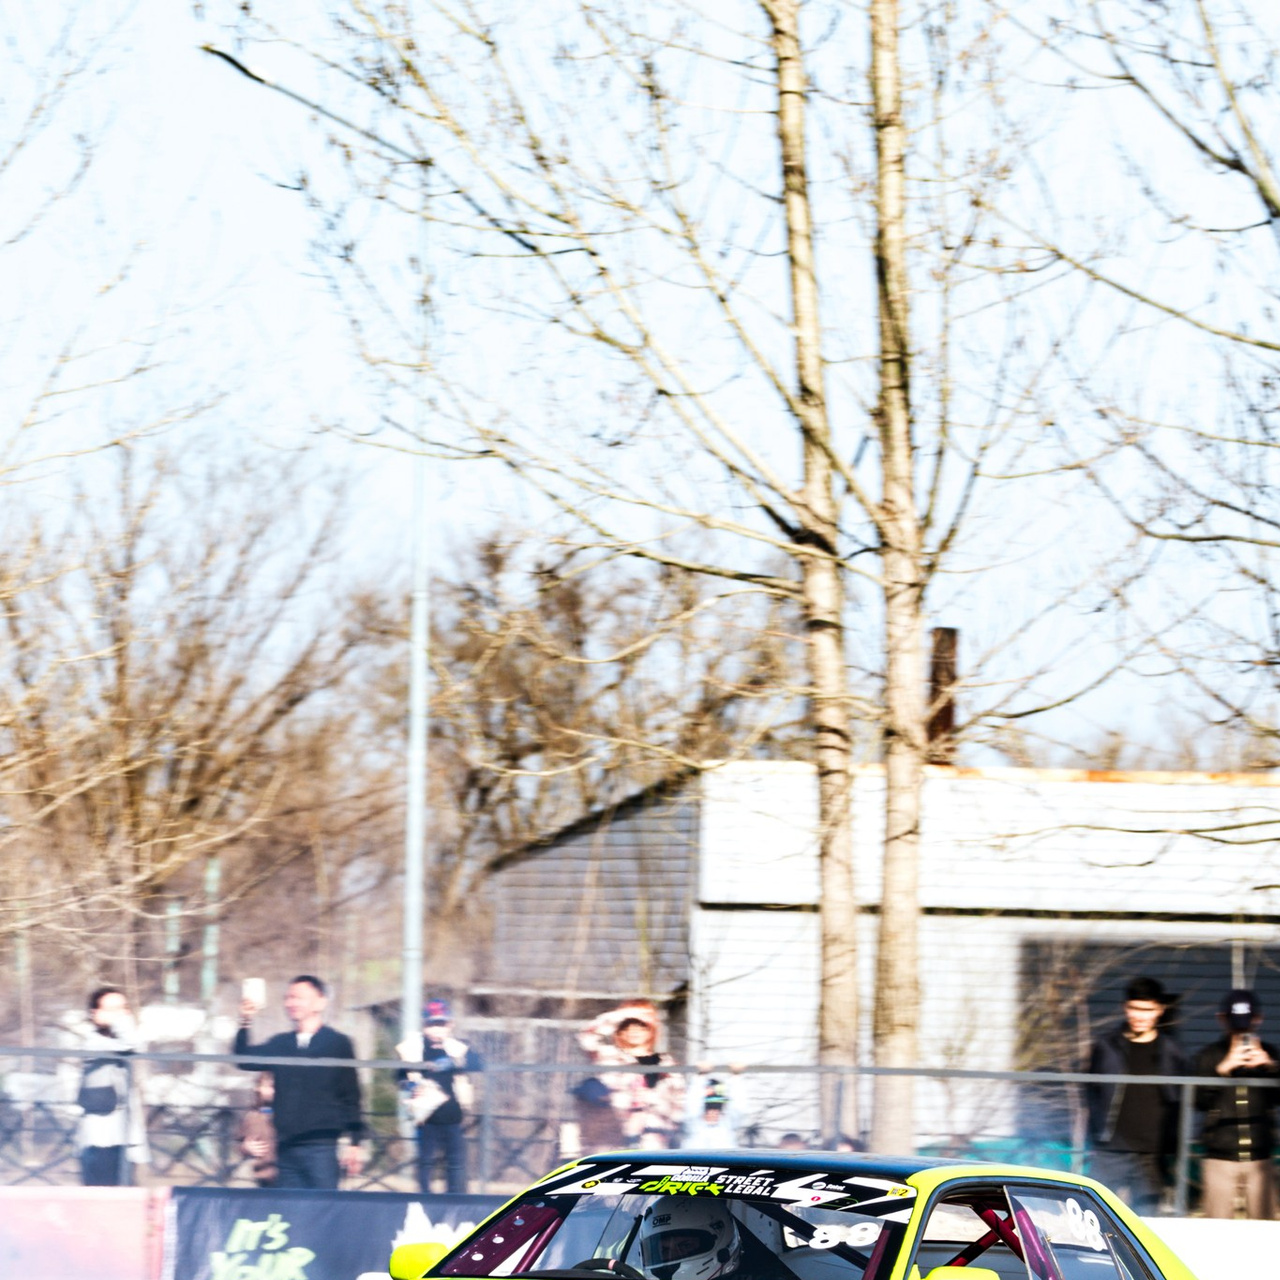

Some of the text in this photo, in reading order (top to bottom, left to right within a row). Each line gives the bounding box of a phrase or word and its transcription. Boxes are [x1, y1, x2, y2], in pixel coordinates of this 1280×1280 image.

[714, 1174, 775, 1187] STREET
[723, 1185, 771, 1196] LEGAL
[1066, 1198, 1107, 1251] 88
[808, 1222, 879, 1249] 88
